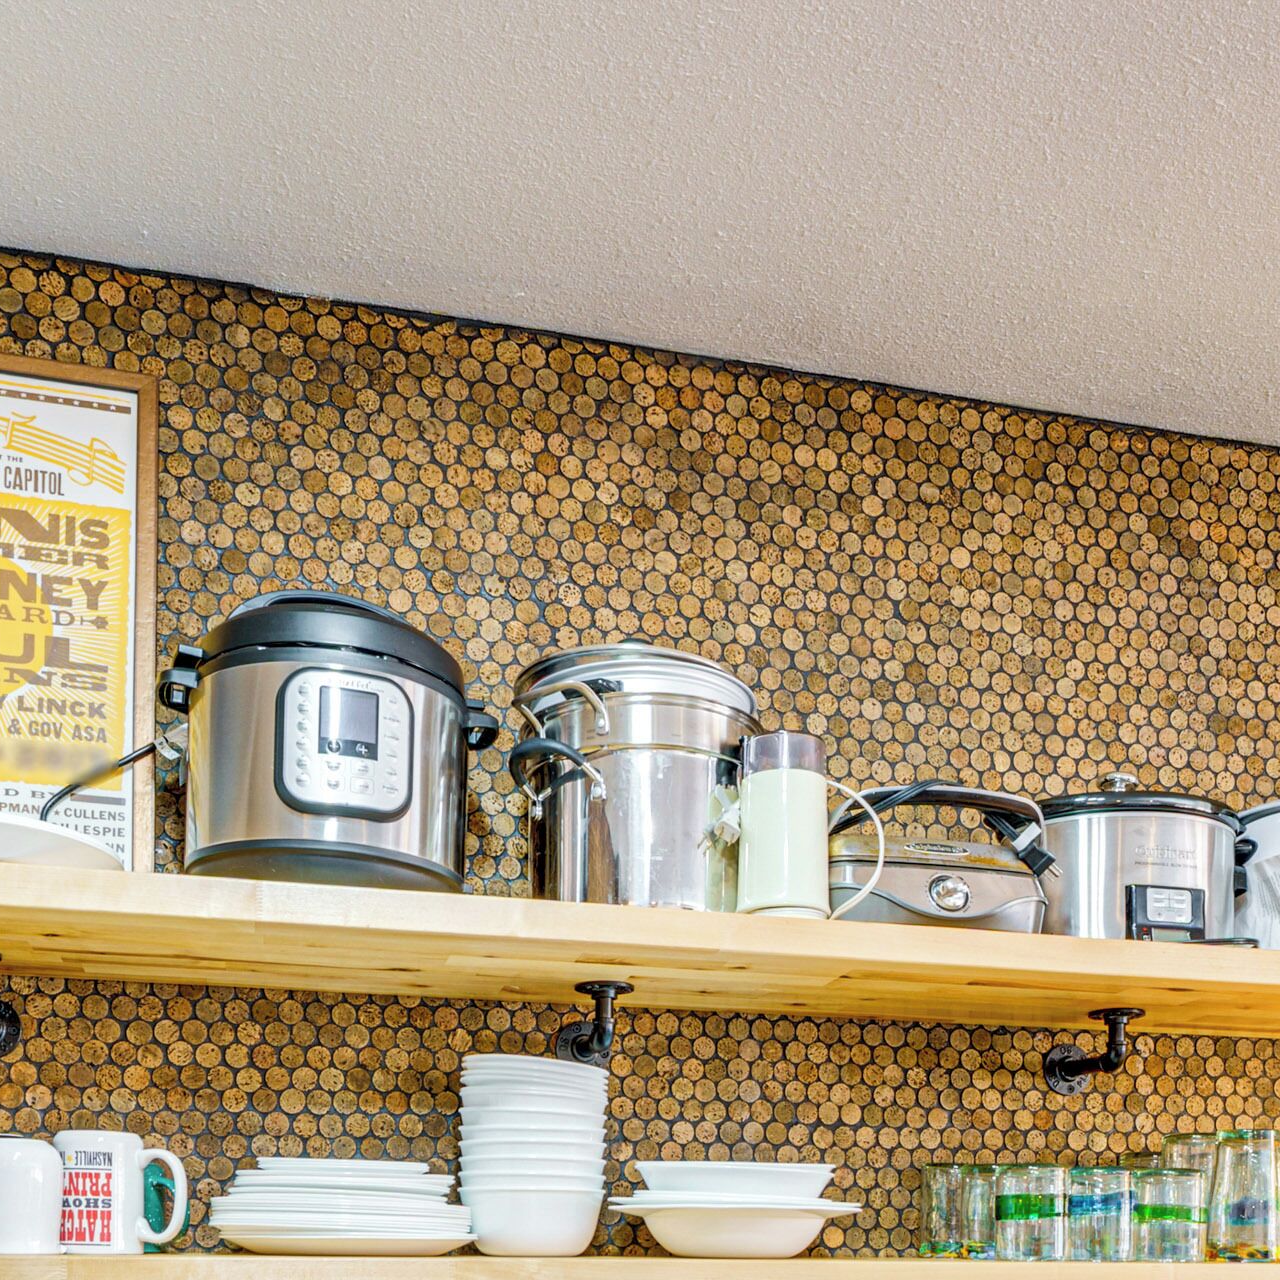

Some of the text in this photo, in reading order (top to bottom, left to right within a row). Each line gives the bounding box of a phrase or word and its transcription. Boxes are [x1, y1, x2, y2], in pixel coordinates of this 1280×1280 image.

[7, 455, 23, 463] THE
[4, 466, 64, 496] CAPITOL
[18, 695, 107, 719] LINCK
[8, 719, 21, 735] &
[29, 720, 62, 739] GOV
[72, 725, 108, 743] ASA
[64, 807, 126, 821] CULLENS
[75, 1151, 112, 1166] NASHVILLE
